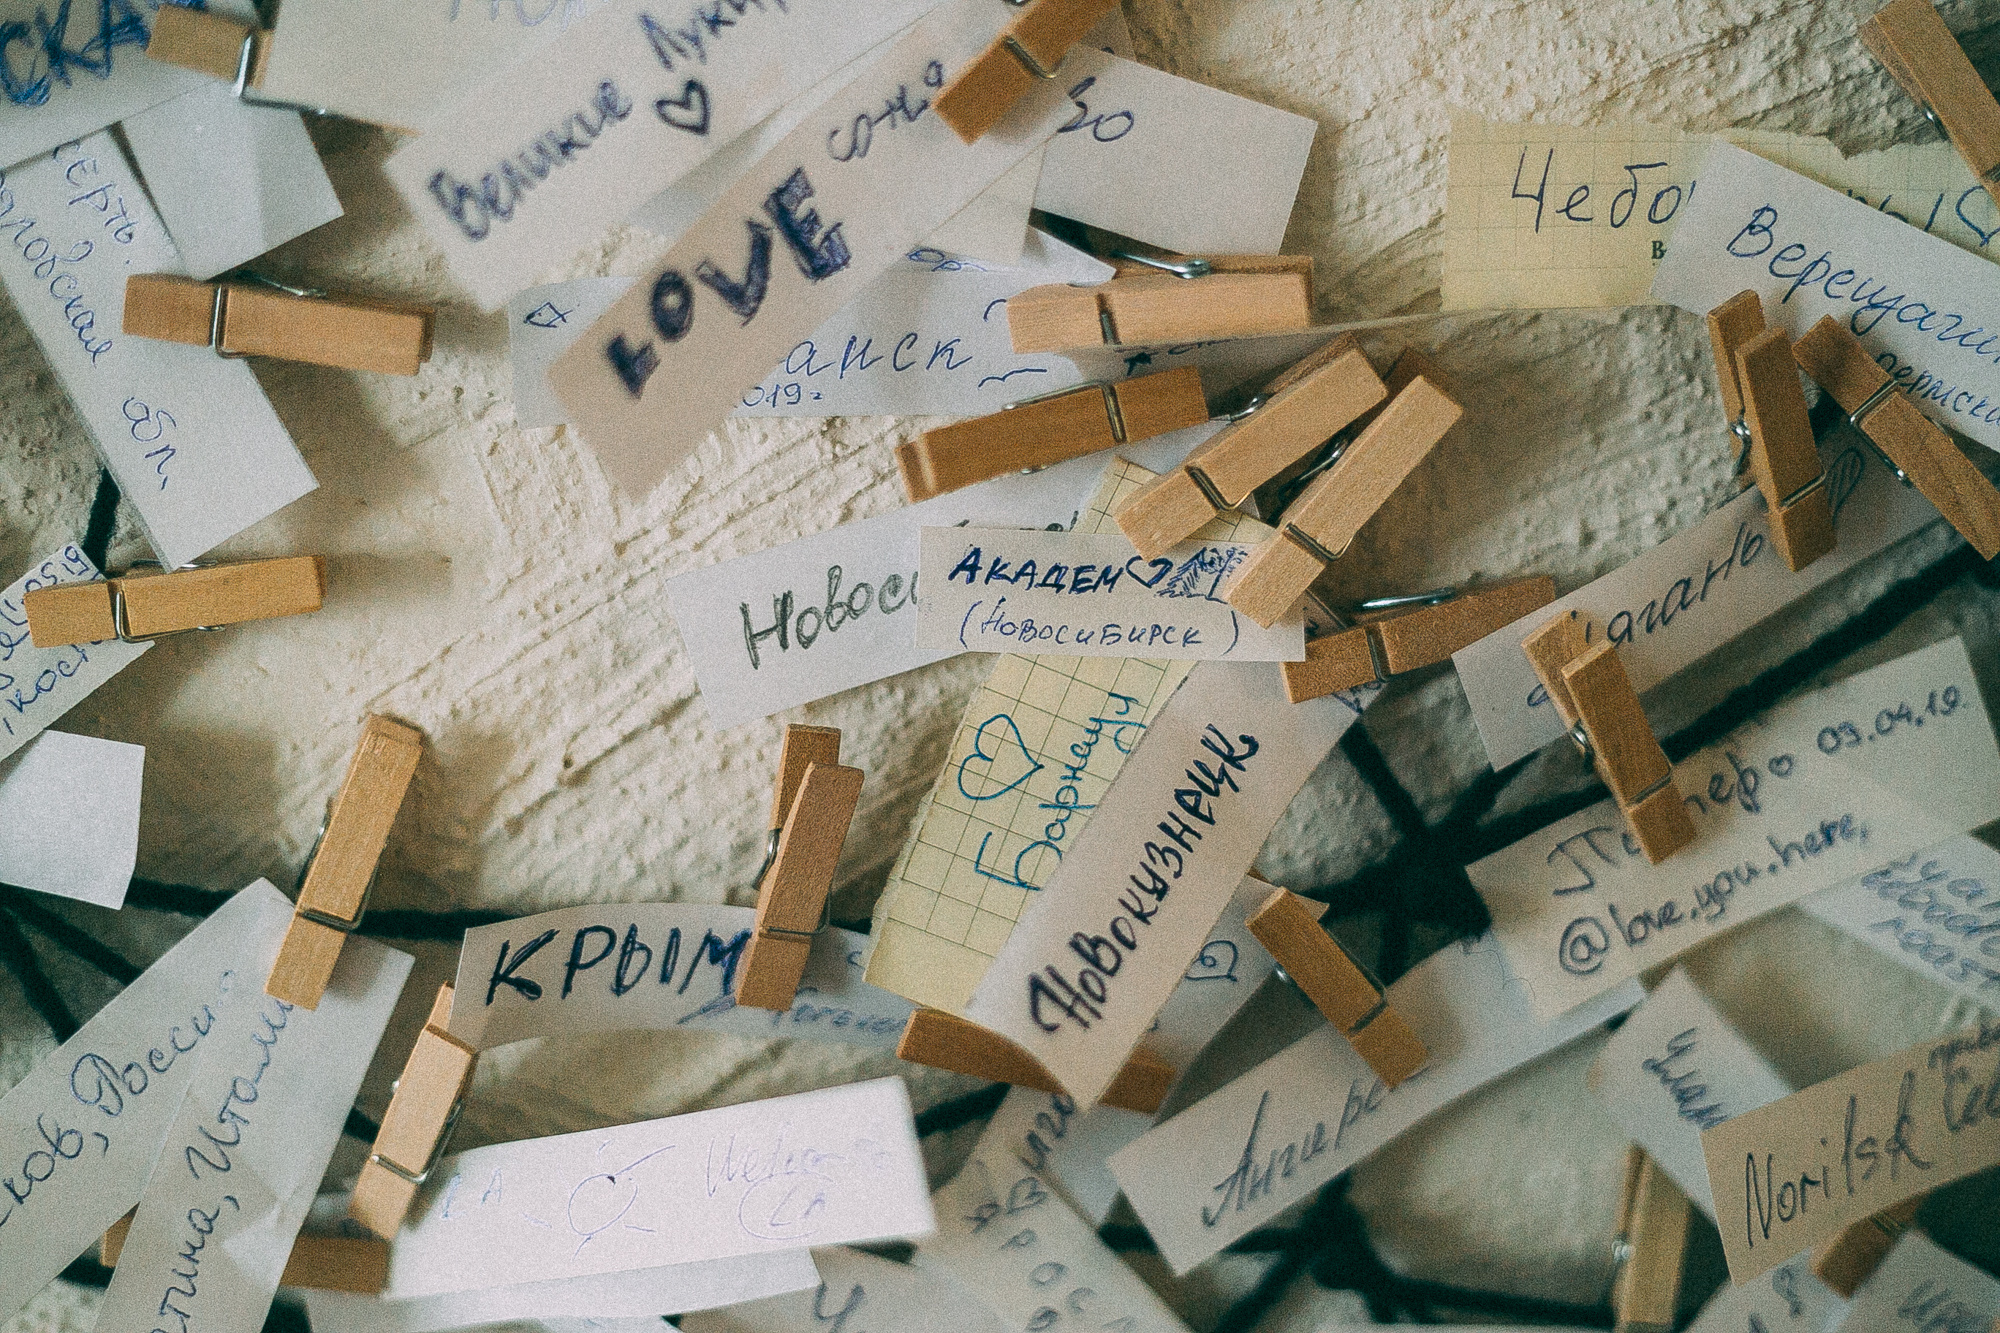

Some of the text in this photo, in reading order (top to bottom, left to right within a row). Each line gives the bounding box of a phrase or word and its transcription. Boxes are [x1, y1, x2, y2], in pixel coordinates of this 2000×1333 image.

[603, 165, 853, 402] LOVE
[1727, 203, 2000, 364] Верещаги
[1570, 521, 1764, 649] ягань
[486, 922, 753, 1006] КРЫМ
